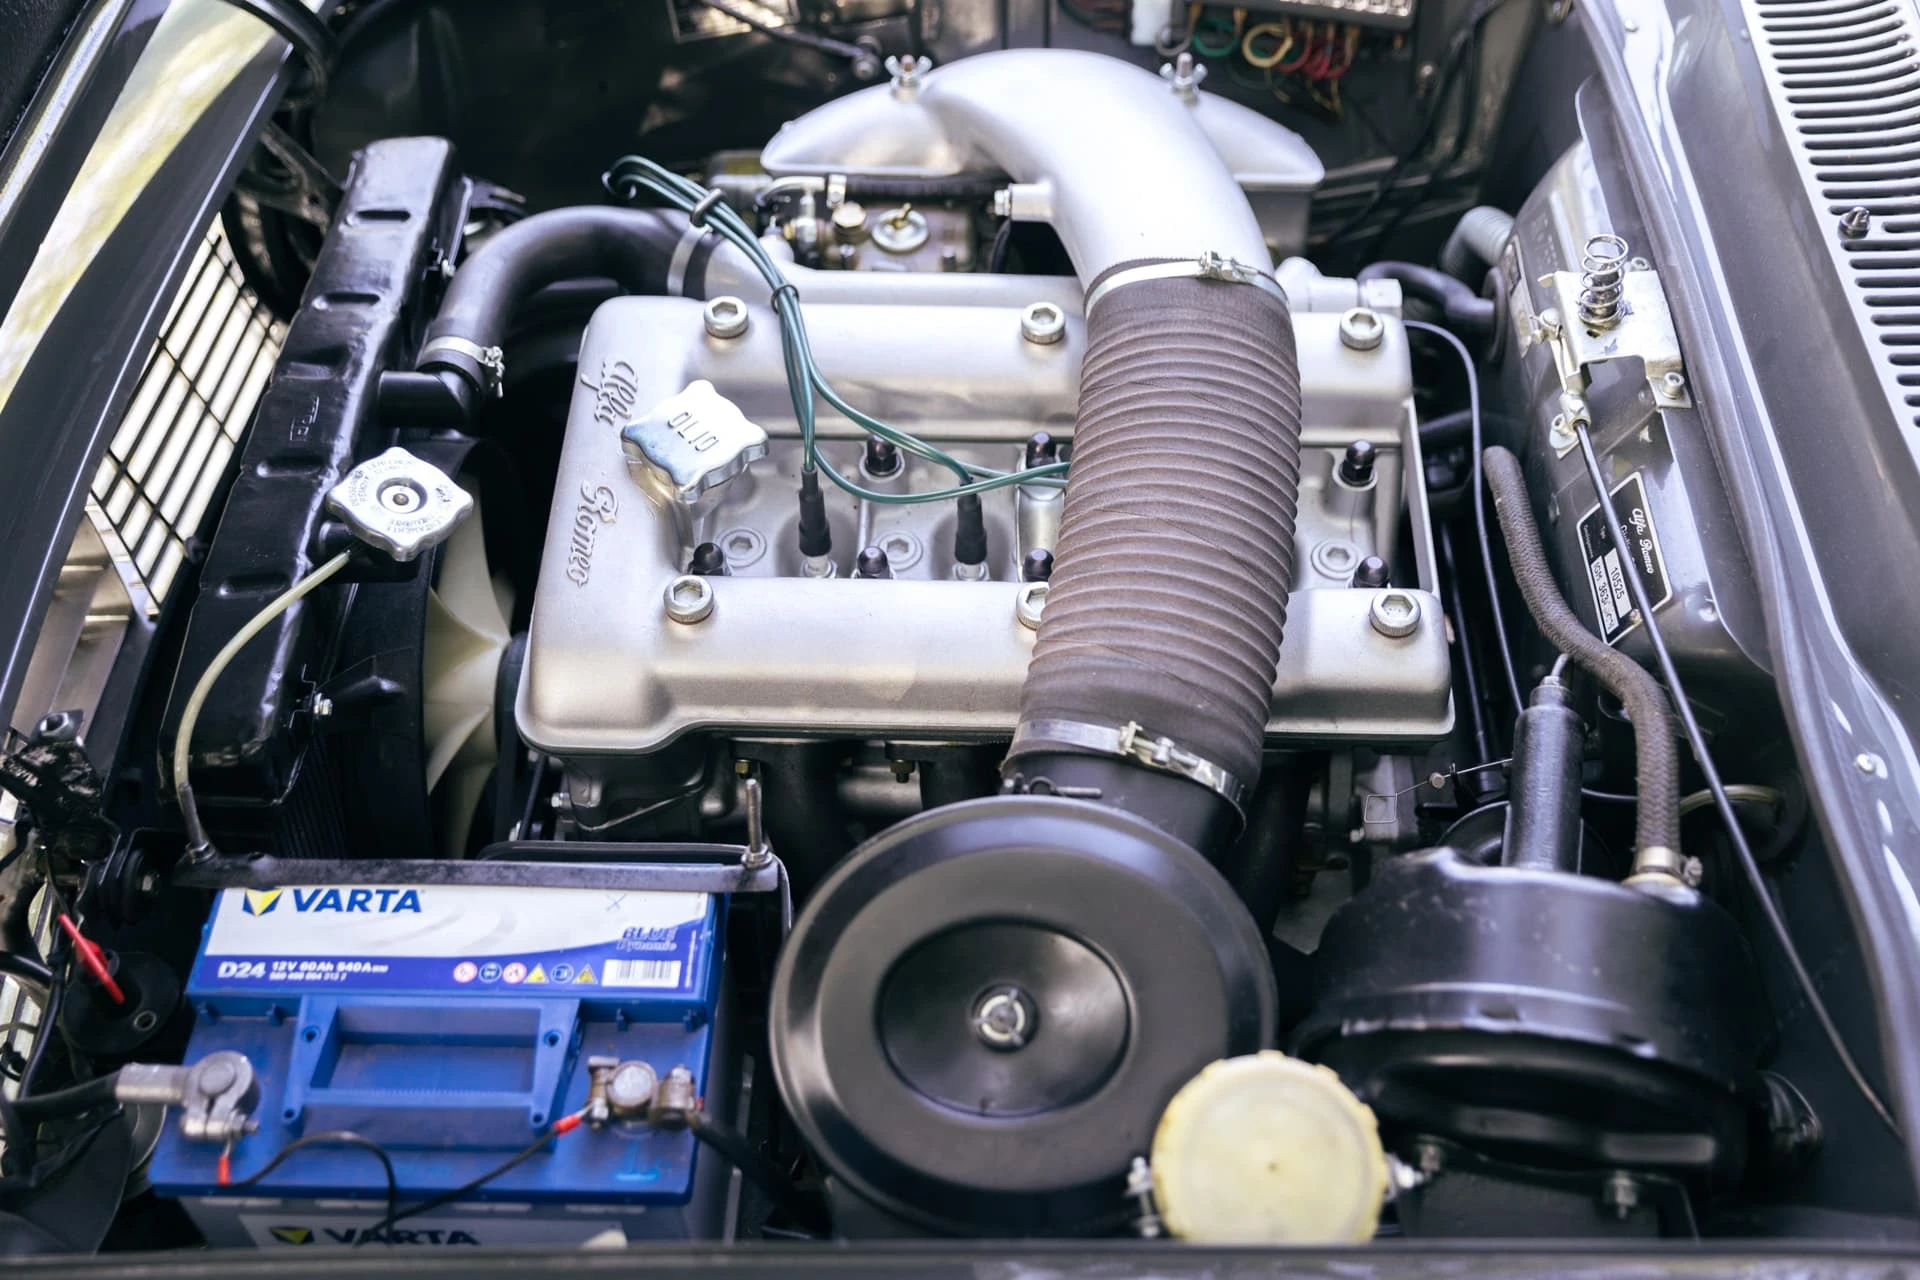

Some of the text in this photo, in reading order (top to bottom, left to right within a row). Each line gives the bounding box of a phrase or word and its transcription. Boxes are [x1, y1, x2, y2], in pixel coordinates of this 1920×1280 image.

[667, 411, 719, 452] OLIO
[567, 360, 638, 588] Alfa Romeo
[1629, 508, 1654, 574] Alfa Romeo
[1610, 567, 1625, 600] 10525
[293, 888, 422, 913] VARTA
[218, 961, 266, 979] D24
[272, 961, 298, 972] 12V
[299, 961, 334, 972] 60Ah
[322, 1228, 481, 1246] VARTA
